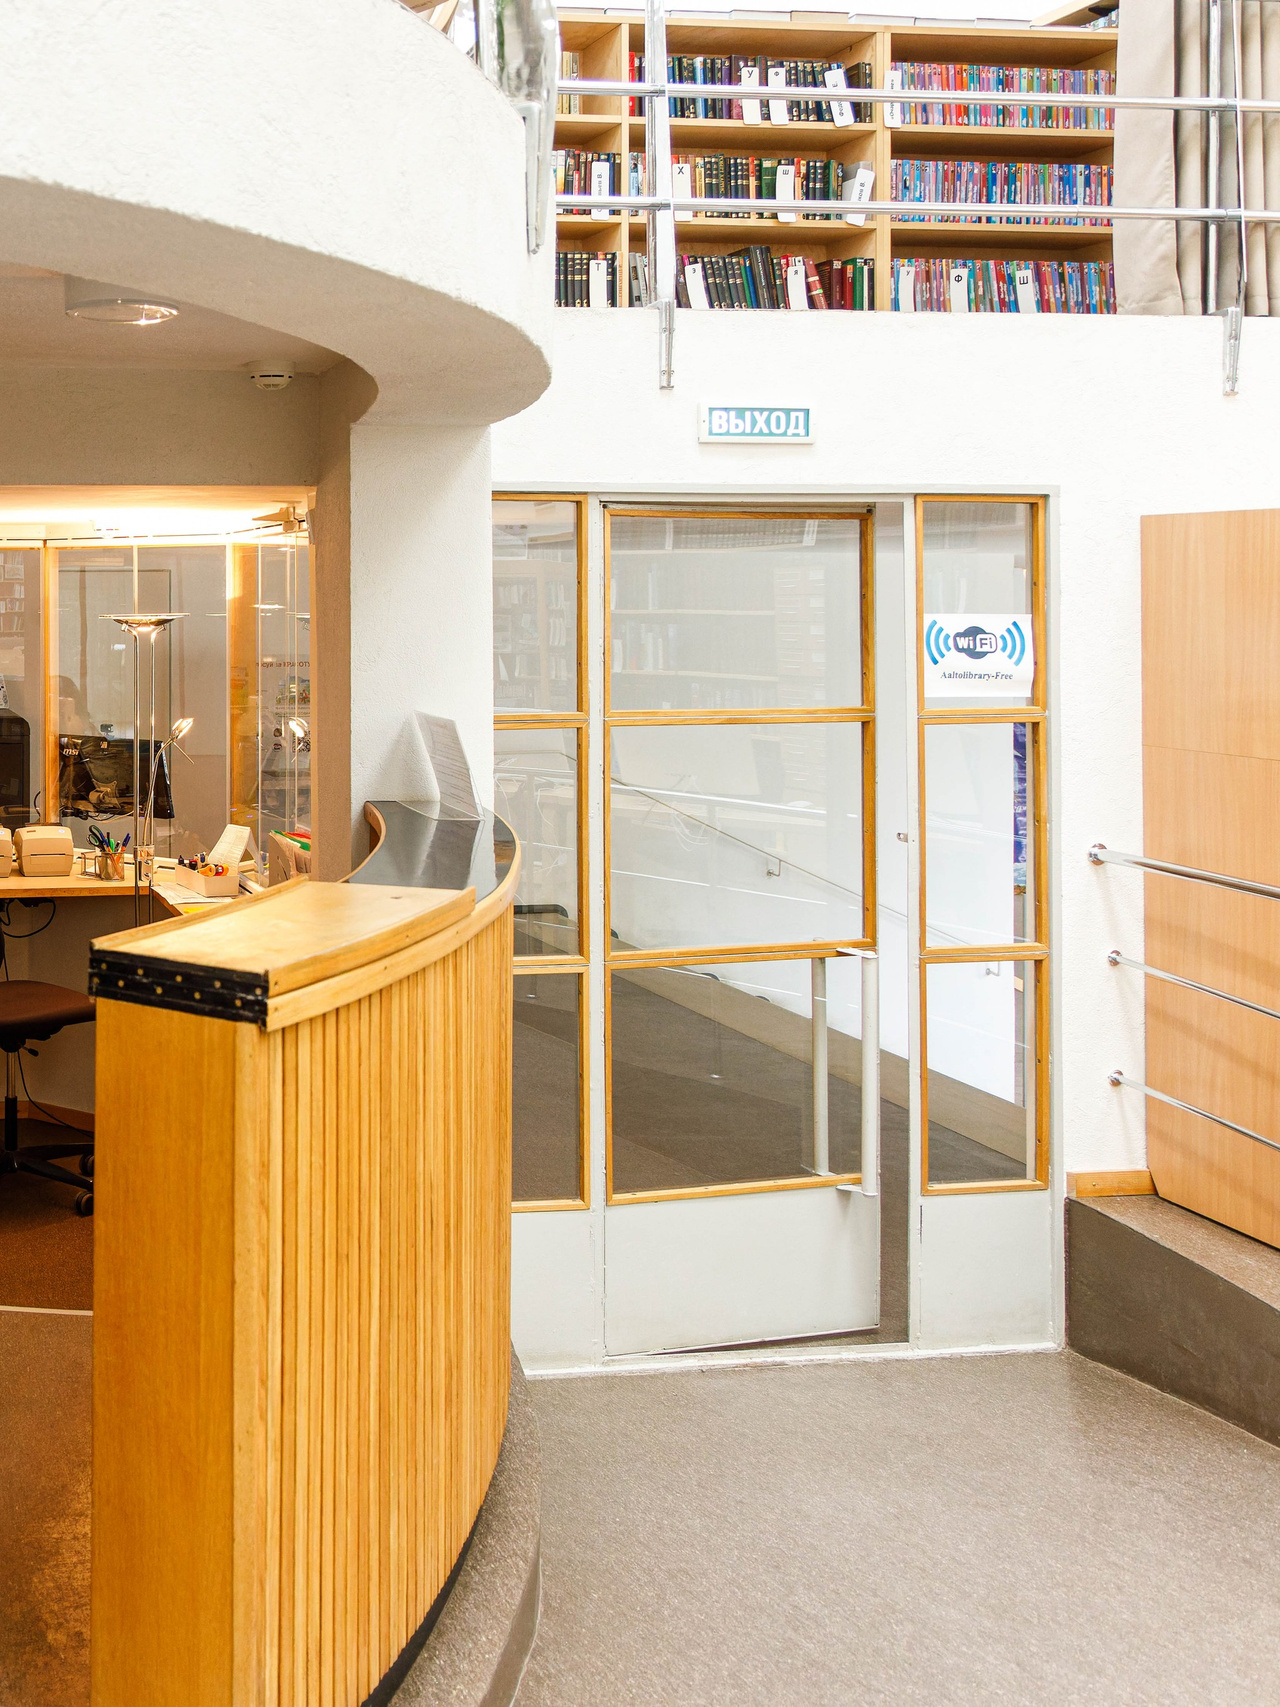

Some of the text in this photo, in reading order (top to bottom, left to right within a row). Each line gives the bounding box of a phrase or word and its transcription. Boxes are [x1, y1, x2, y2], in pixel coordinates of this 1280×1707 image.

[954, 274, 963, 284] Ф
[711, 410, 806, 436] ВЫХОД
[940, 671, 1014, 681] Aaltolibrary-Free
[63, 748, 79, 757] msi
